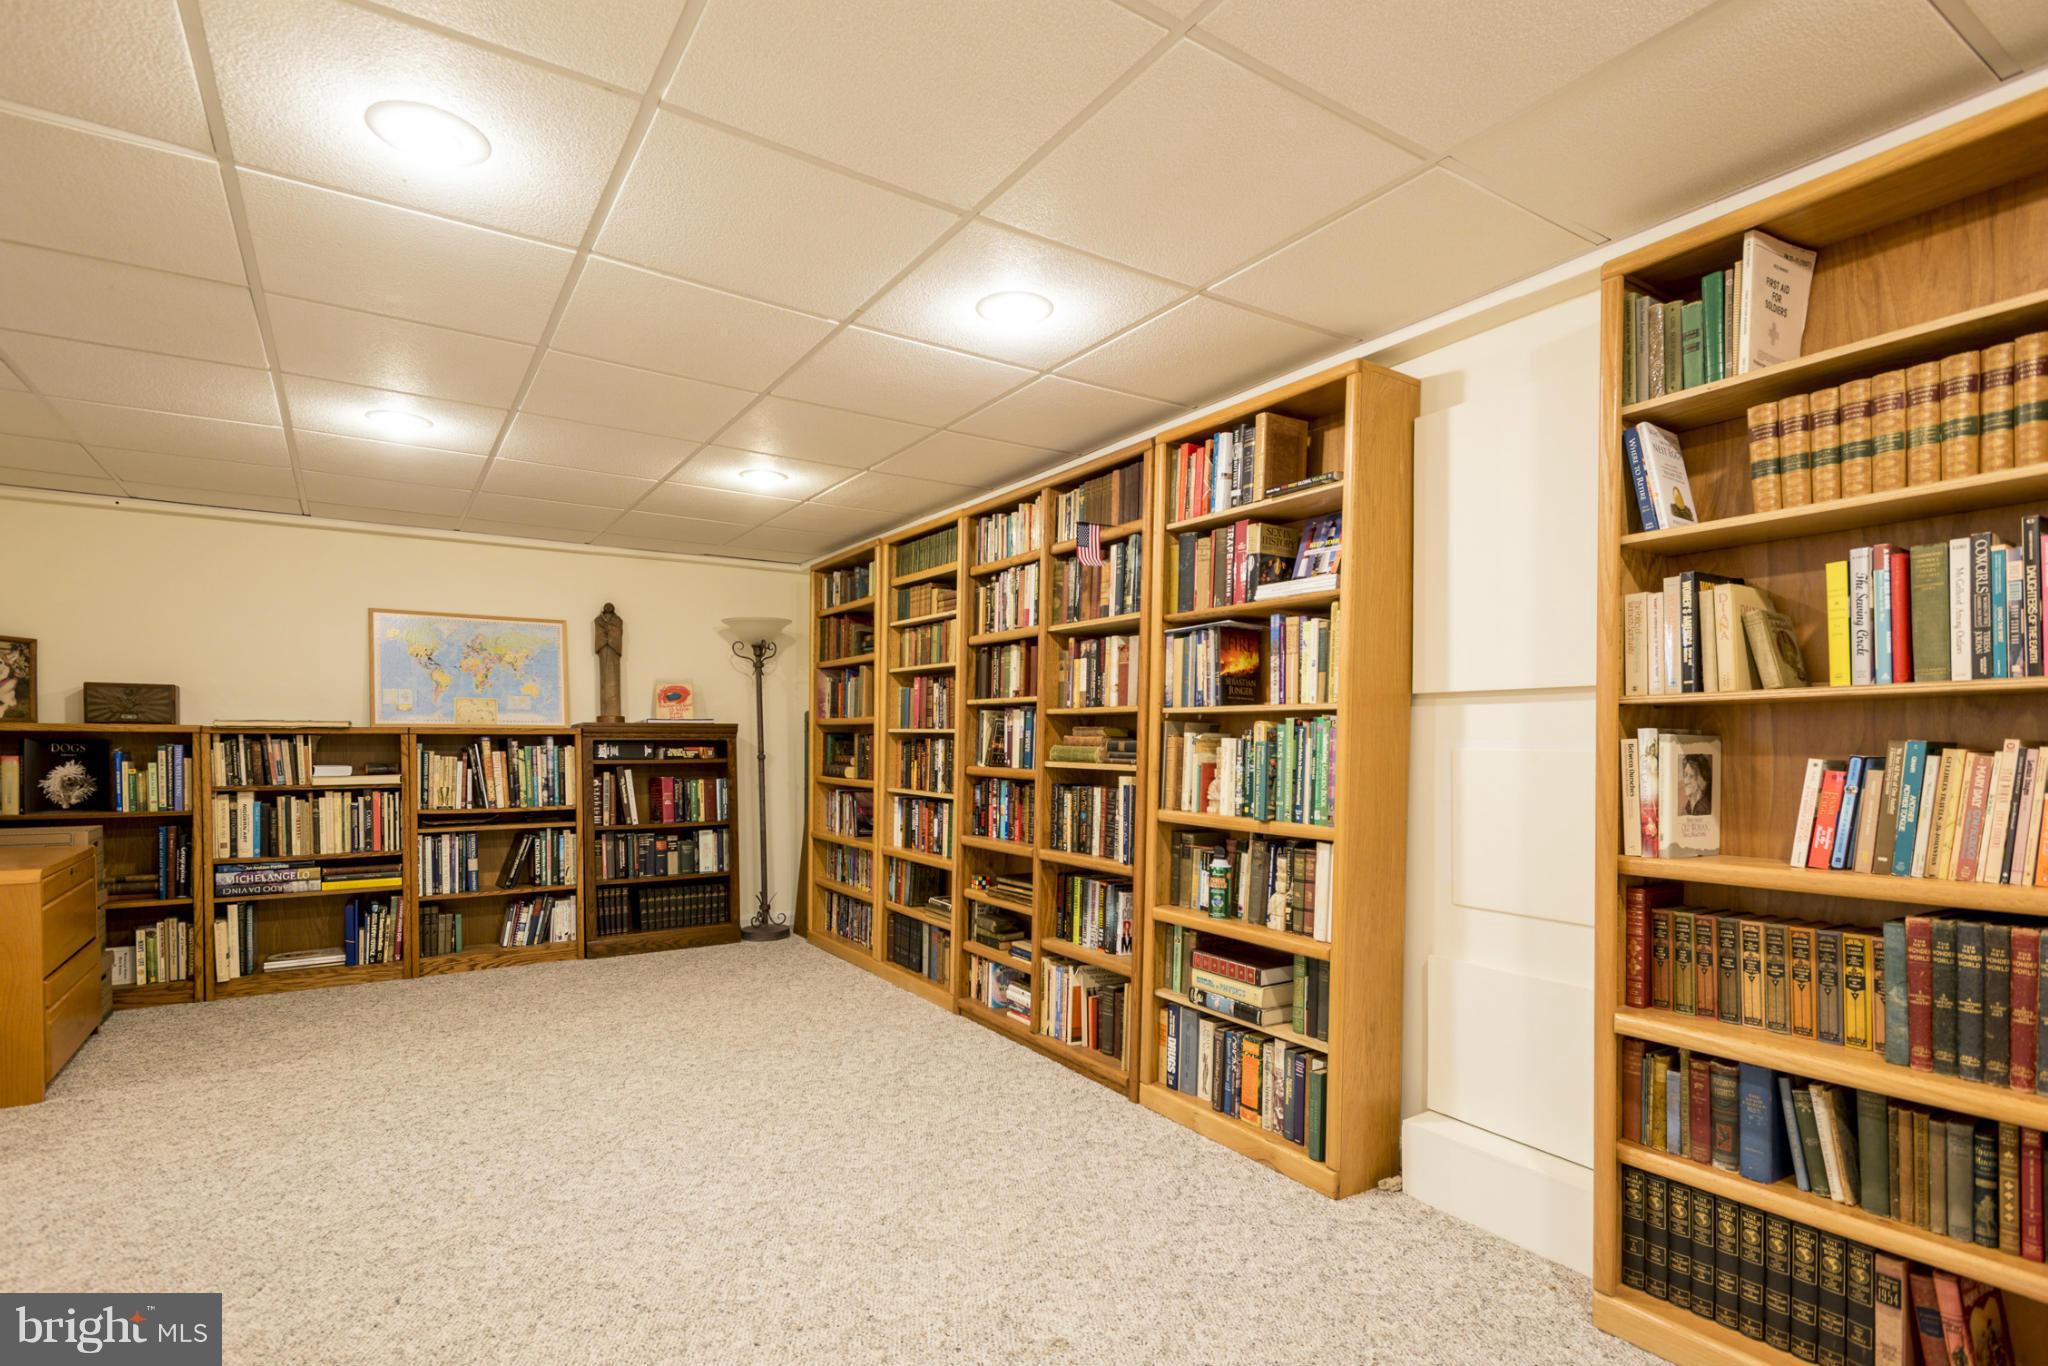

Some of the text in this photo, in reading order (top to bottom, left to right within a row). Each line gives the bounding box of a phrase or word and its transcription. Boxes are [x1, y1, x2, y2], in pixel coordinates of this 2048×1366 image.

[1766, 276, 1790, 294] FIRST AID
[1772, 291, 1782, 303] FOR
[1765, 299, 1788, 318] SOLDIERS
[1265, 527, 1283, 537] SEX
[1262, 536, 1296, 549] HISTORY
[1975, 539, 1989, 594] COWGIRLS
[2027, 565, 2037, 615] DAUGHTERS
[1854, 592, 1867, 626] Sewing
[1718, 593, 1729, 641] DIANA
[1857, 628, 1869, 656] Circle
[1225, 677, 1257, 687] SEBASTIAN
[1228, 685, 1254, 696] JUNGER
[50, 743, 87, 754] DOGS
[1627, 743, 1635, 769] Between
[225, 871, 311, 884] MICHELANGELO
[222, 887, 247, 895] VINCI
[1909, 954, 1930, 962] WORLD
[1958, 961, 1980, 969] WORLD
[1986, 964, 2009, 972] WORLD
[2013, 968, 2036, 976] WORLD
[1167, 1038, 1176, 1074] DRUGS
[1879, 1287, 1899, 1307] 1954
